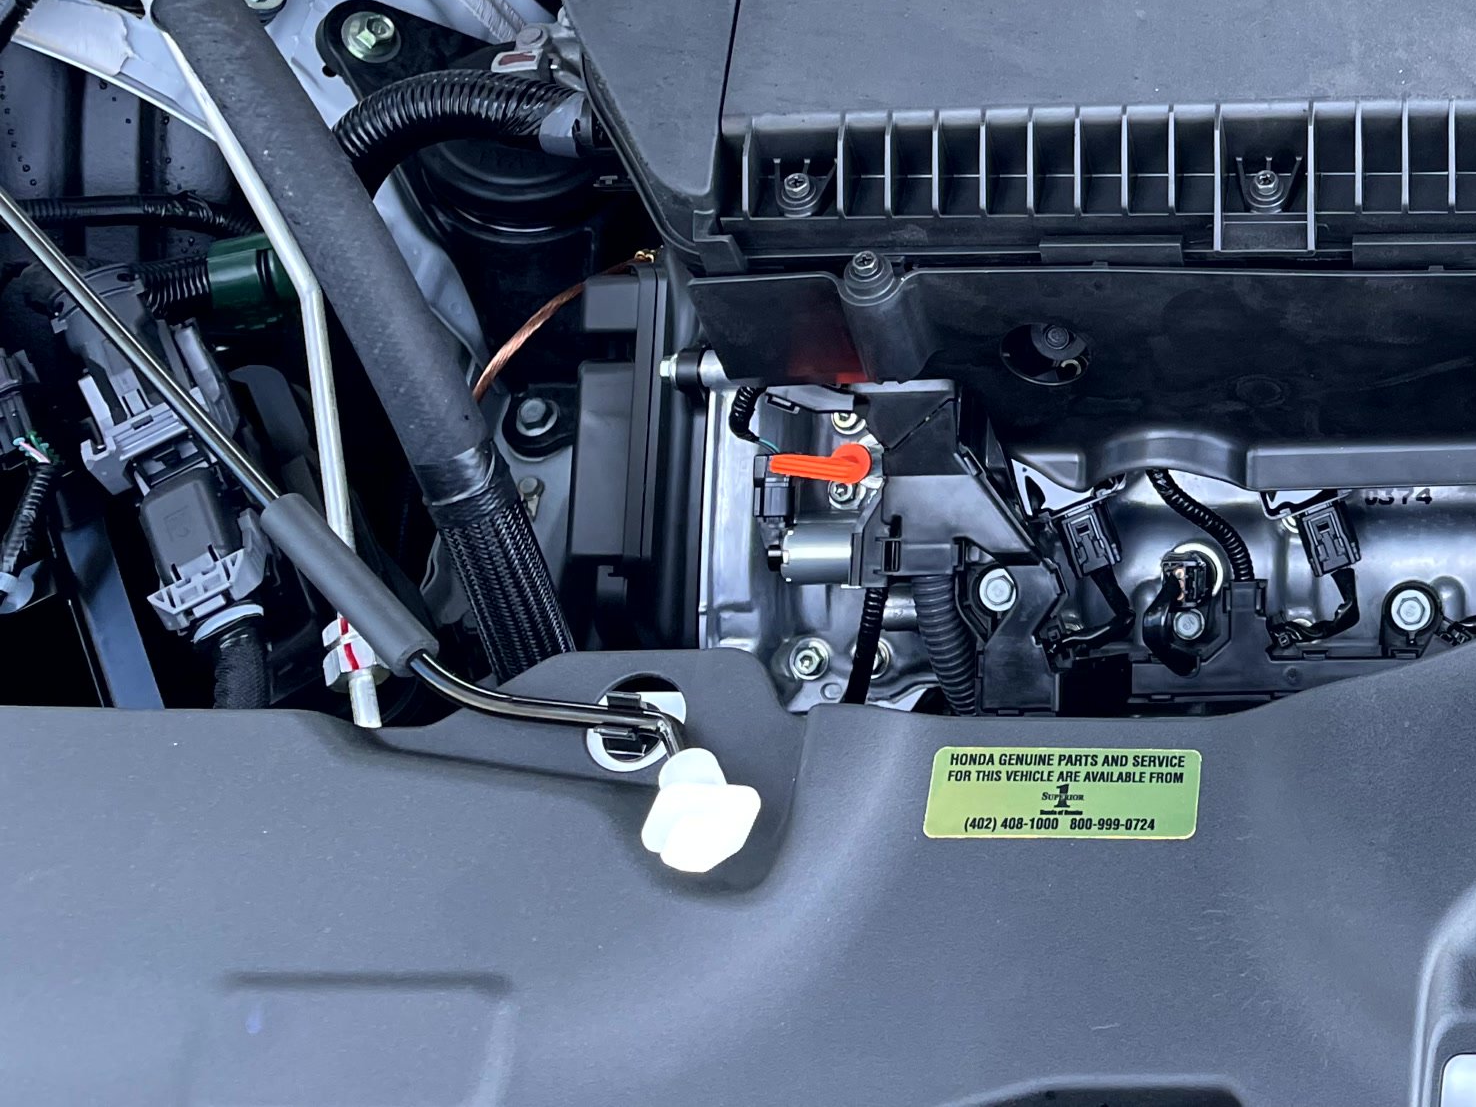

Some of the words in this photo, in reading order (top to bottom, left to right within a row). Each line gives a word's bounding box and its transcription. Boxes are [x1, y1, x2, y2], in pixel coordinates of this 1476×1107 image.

[950, 753, 995, 766] HONDA
[999, 753, 1054, 766] GENUINE
[1057, 754, 1099, 767] PARTS
[1101, 755, 1129, 767] AND
[1132, 755, 1186, 768] SERVICE
[947, 770, 972, 782] FOR
[975, 770, 1002, 782] THIS
[1005, 770, 1054, 782] VEHICLE
[1056, 771, 1081, 783] ARE
[1083, 771, 1146, 783] AVAILABLE
[1149, 772, 1184, 784] FROM
[964, 817, 997, 832] (402)
[1000, 817, 1059, 830] 408-1000
[1069, 818, 1155, 831] 800-999-0724
